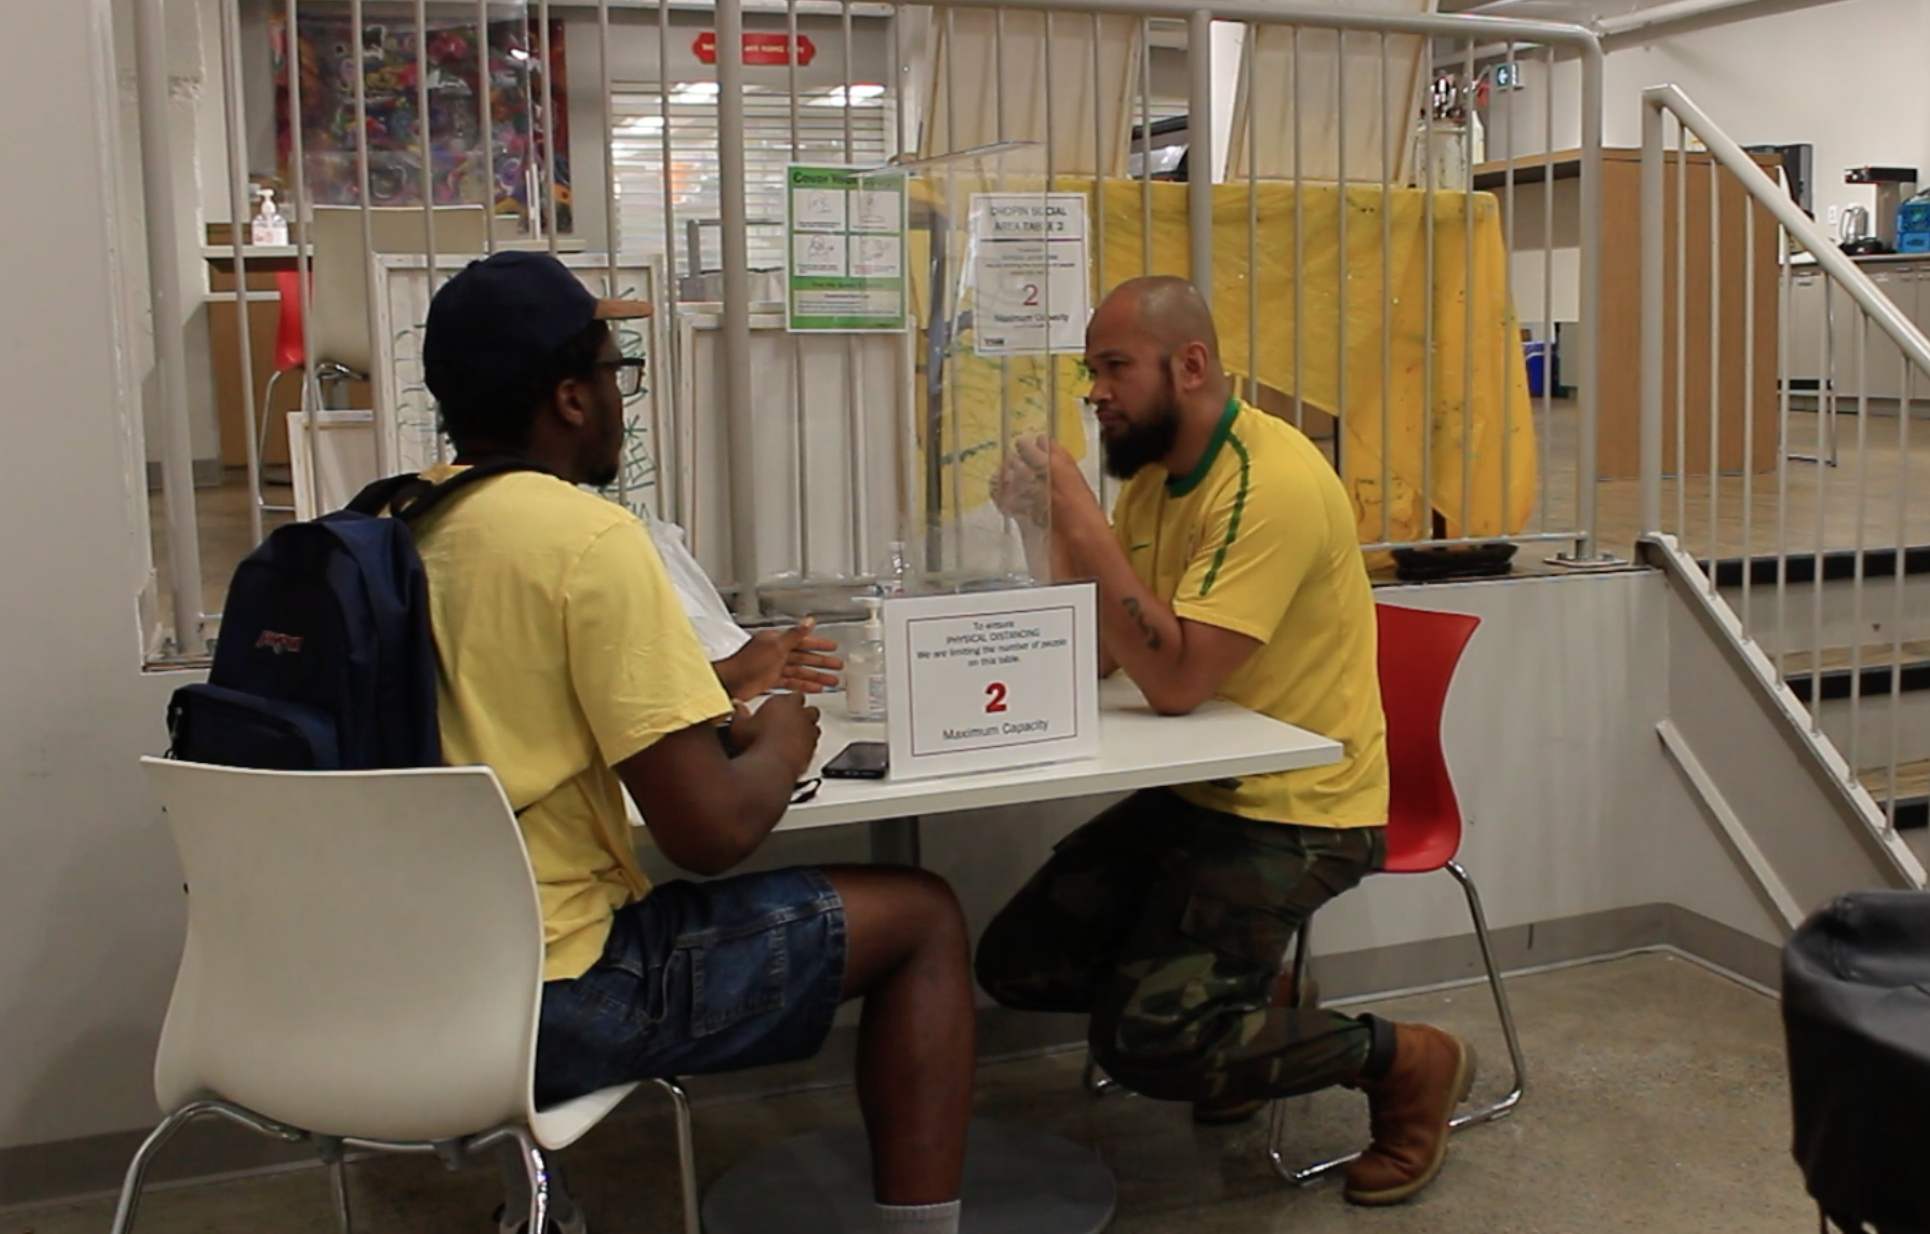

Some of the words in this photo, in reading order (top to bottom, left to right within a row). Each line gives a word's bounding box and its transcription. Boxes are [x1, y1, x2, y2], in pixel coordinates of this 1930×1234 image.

[1022, 221, 1054, 232] TABE
[1023, 284, 1039, 307] 2
[973, 622, 984, 631] To
[985, 621, 1014, 630] ensure
[946, 634, 988, 644] PHYSICAL
[989, 628, 1041, 642] DISTANCING
[917, 651, 930, 659] We
[933, 650, 947, 658] are
[950, 646, 981, 657] limiting
[982, 644, 996, 654] the
[998, 642, 1030, 652] number
[1031, 640, 1040, 649] of
[1040, 638, 1068, 650] people
[968, 659, 979, 667] on
[981, 657, 996, 666] this
[985, 682, 1008, 713] 2
[942, 725, 1000, 741] Maximum
[1001, 719, 1049, 735] Capacity
